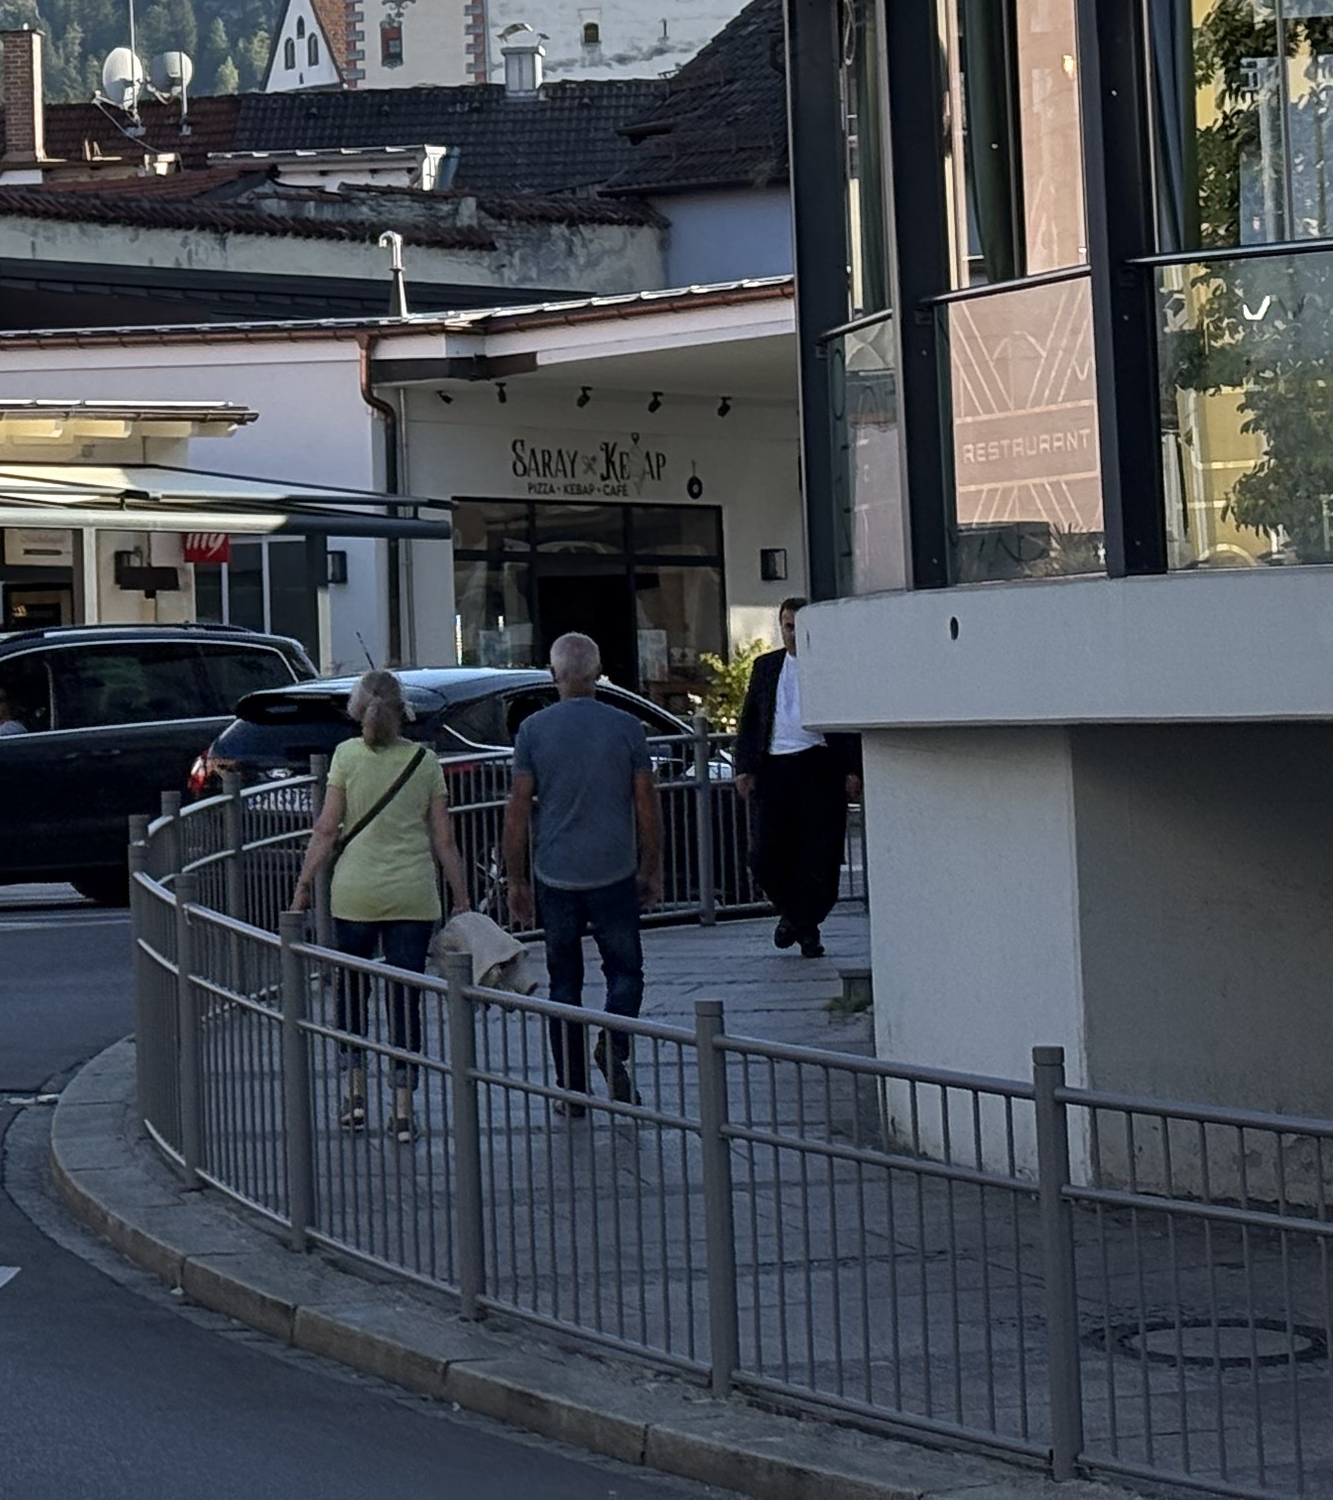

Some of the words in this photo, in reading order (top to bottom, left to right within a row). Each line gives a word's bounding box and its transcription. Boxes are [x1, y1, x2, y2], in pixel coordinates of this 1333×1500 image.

[599, 440, 667, 484] KEAP
[963, 428, 1091, 464] RESTAURANT
[527, 482, 556, 495] PIZZA
[563, 483, 595, 496] KEBAP
